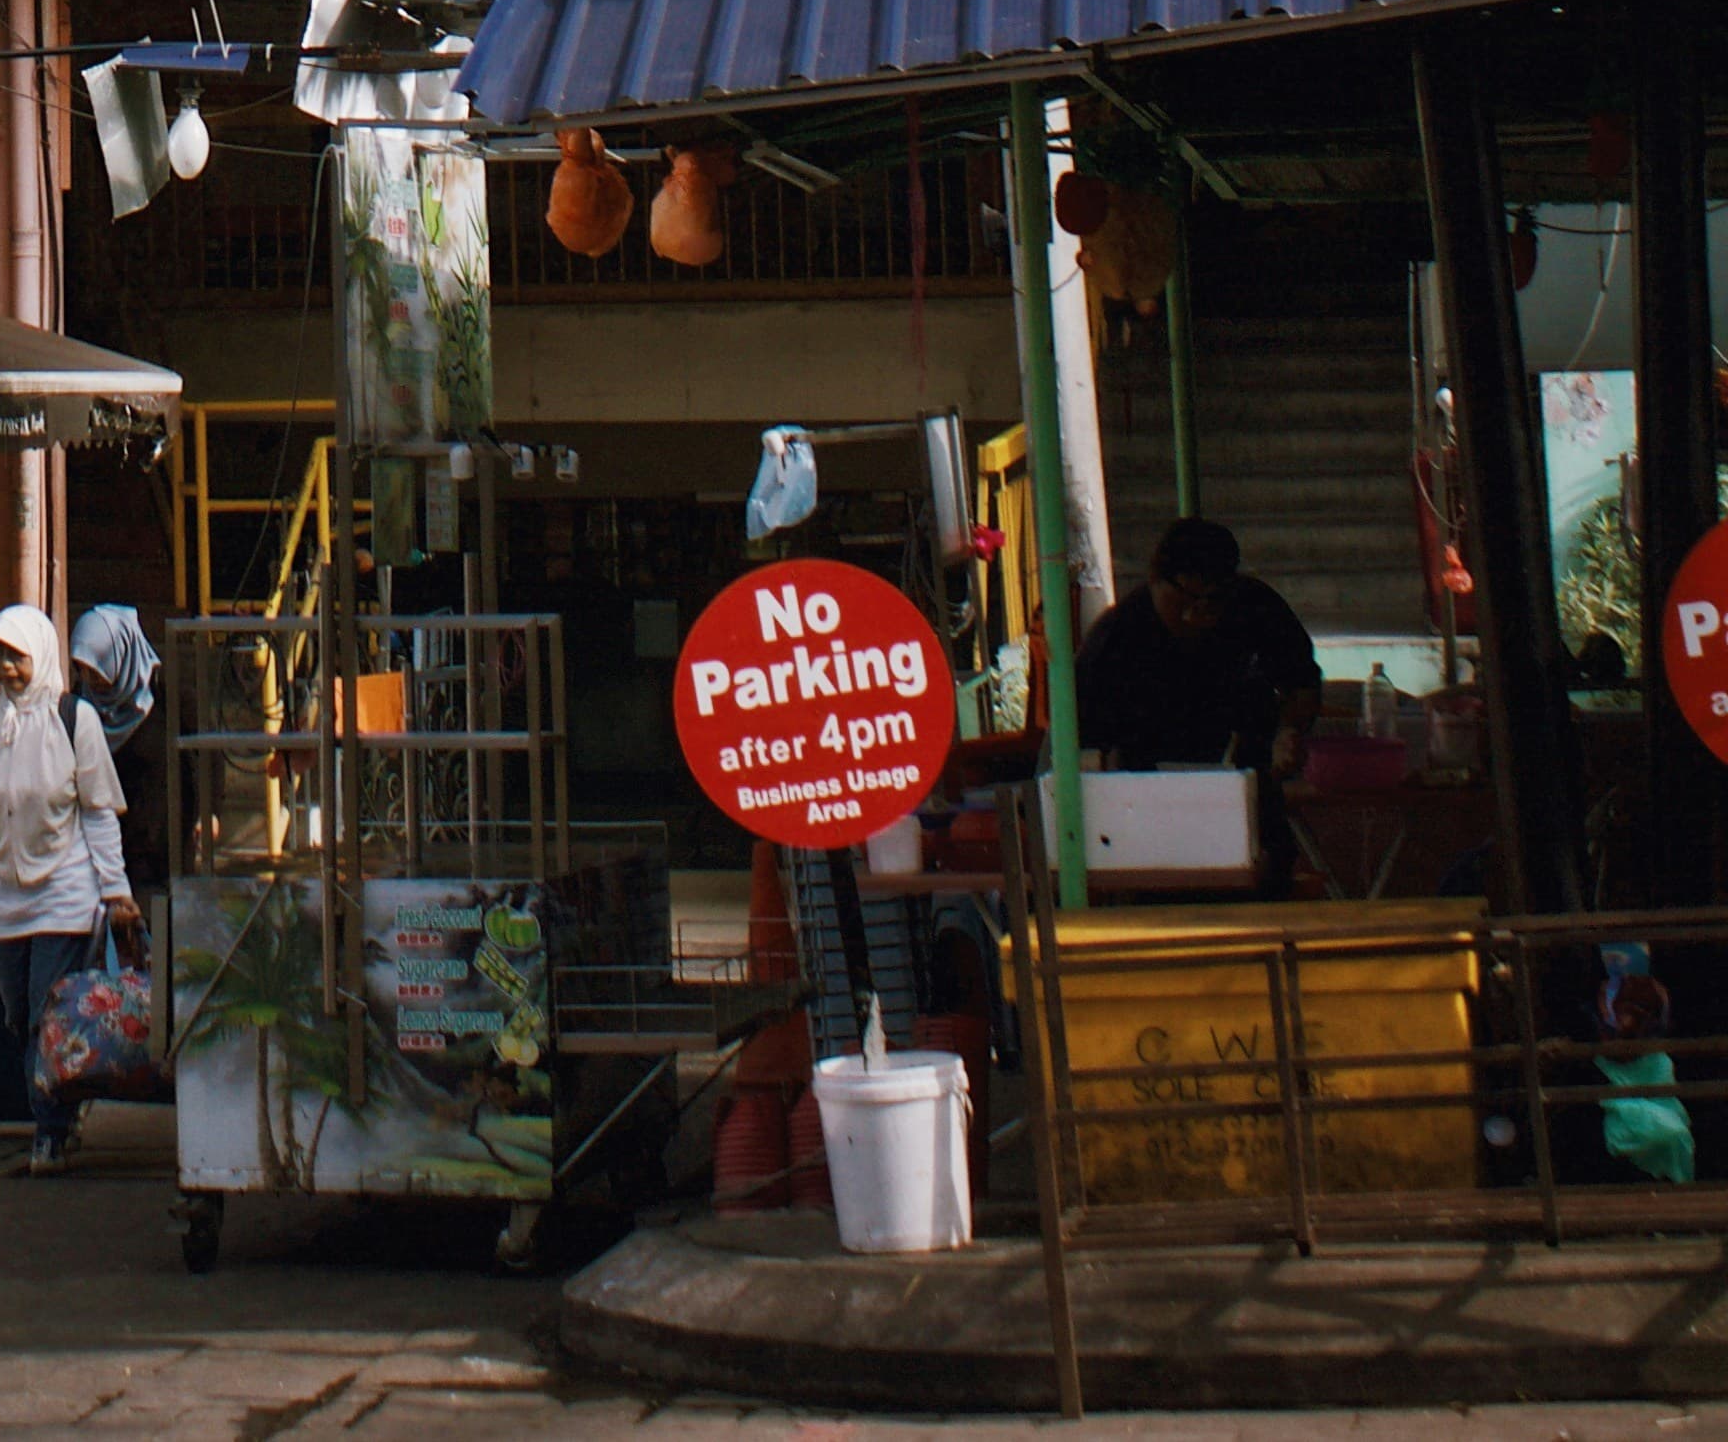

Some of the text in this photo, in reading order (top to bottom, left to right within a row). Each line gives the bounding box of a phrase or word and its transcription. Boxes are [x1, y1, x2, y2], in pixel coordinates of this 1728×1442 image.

[755, 583, 840, 643] No
[690, 639, 928, 717] Parking
[719, 710, 917, 772] after 4pm
[736, 764, 920, 811] Business Usage
[806, 799, 862, 825] Area
